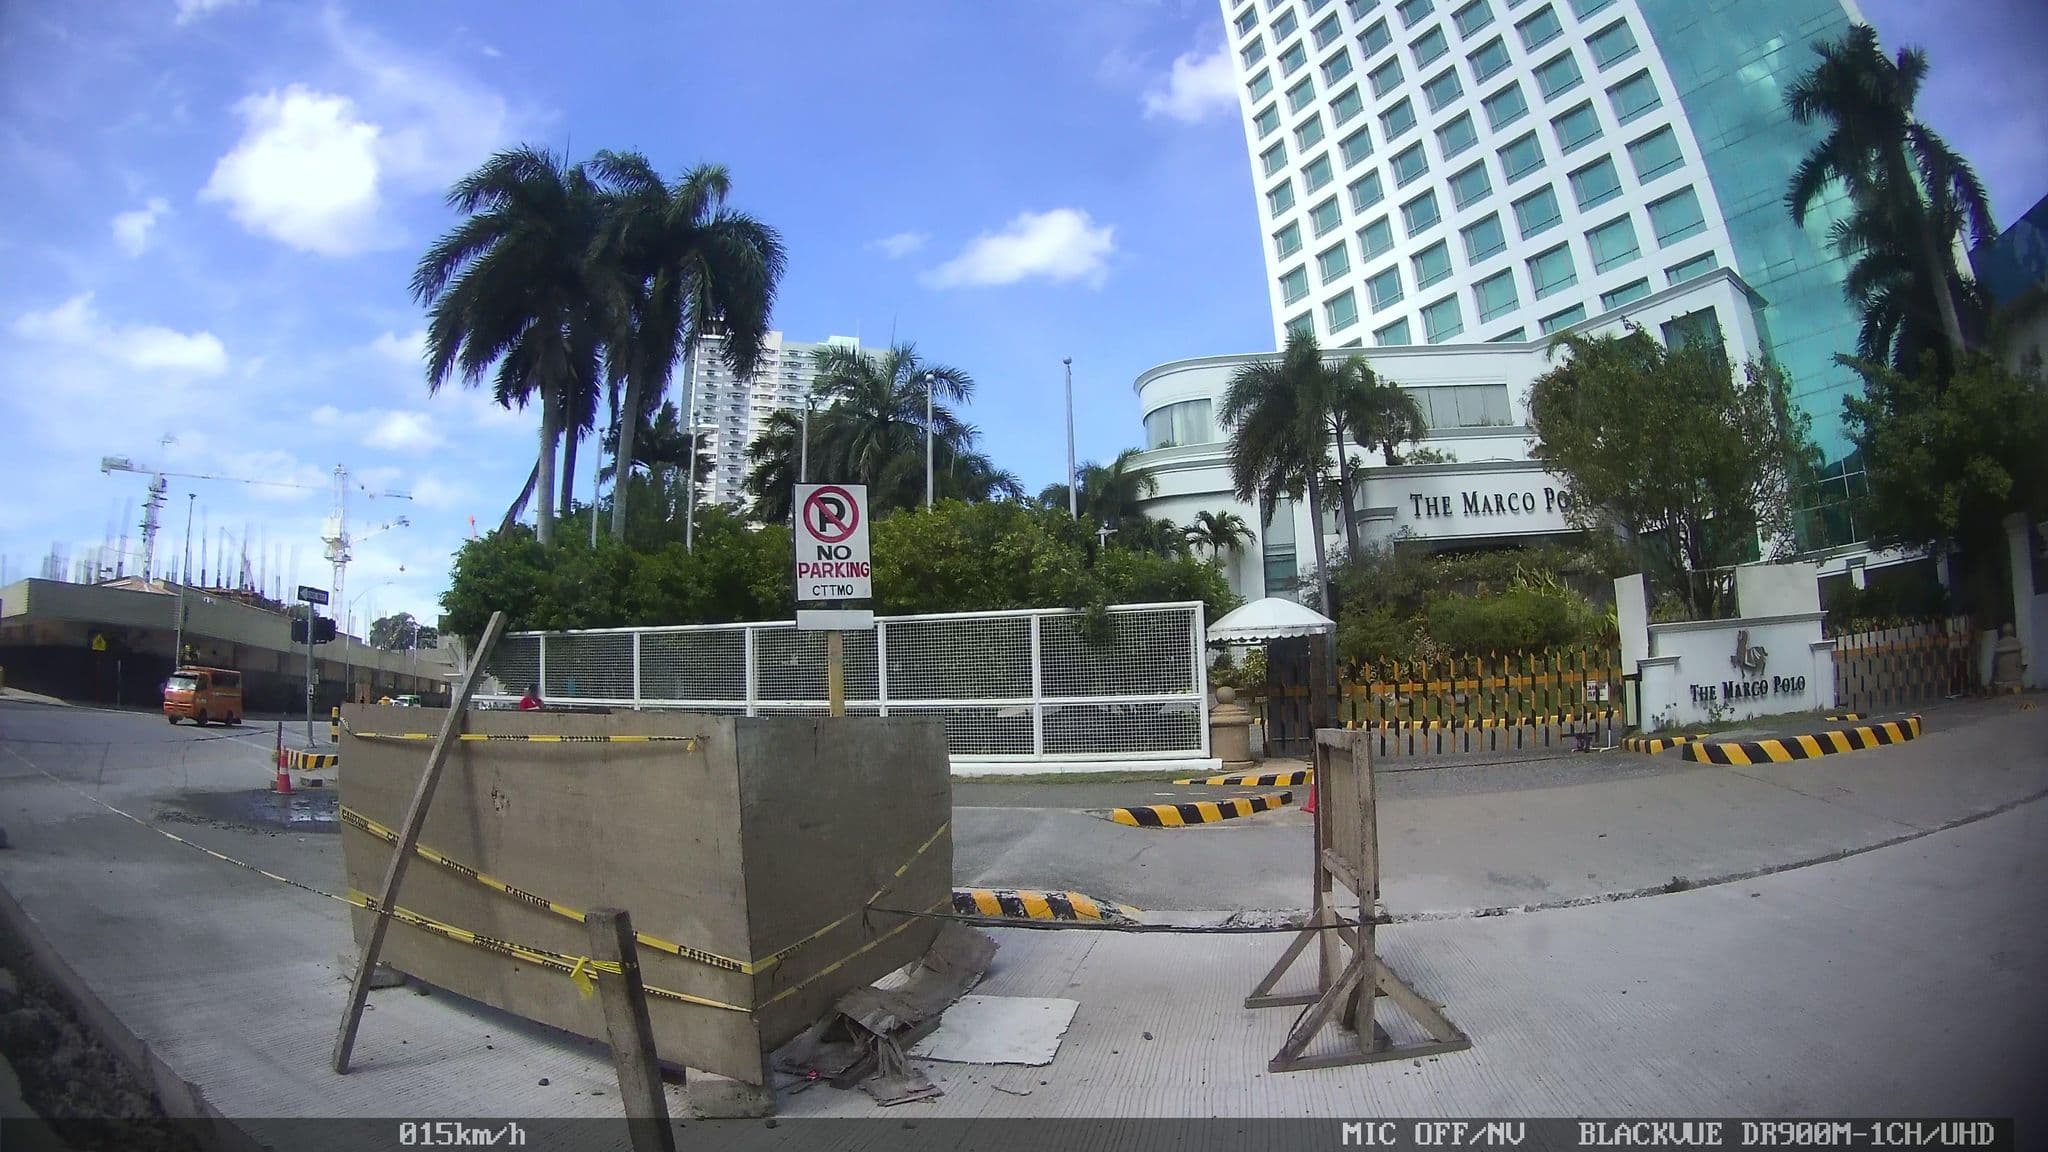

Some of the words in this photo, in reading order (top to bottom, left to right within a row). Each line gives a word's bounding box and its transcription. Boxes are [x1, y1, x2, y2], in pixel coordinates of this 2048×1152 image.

[1410, 493, 1453, 517] THE
[1461, 490, 1536, 514] MARCO
[817, 545, 852, 561] NO
[798, 562, 870, 579] PARKING
[812, 584, 854, 597] CTTMO
[1689, 684, 1717, 702] THE
[1722, 679, 1769, 699] MARCO
[1773, 675, 1806, 693] POLO
[440, 856, 479, 880] CAUTION
[505, 884, 551, 909] CAUTION
[678, 944, 742, 972] CAUTION
